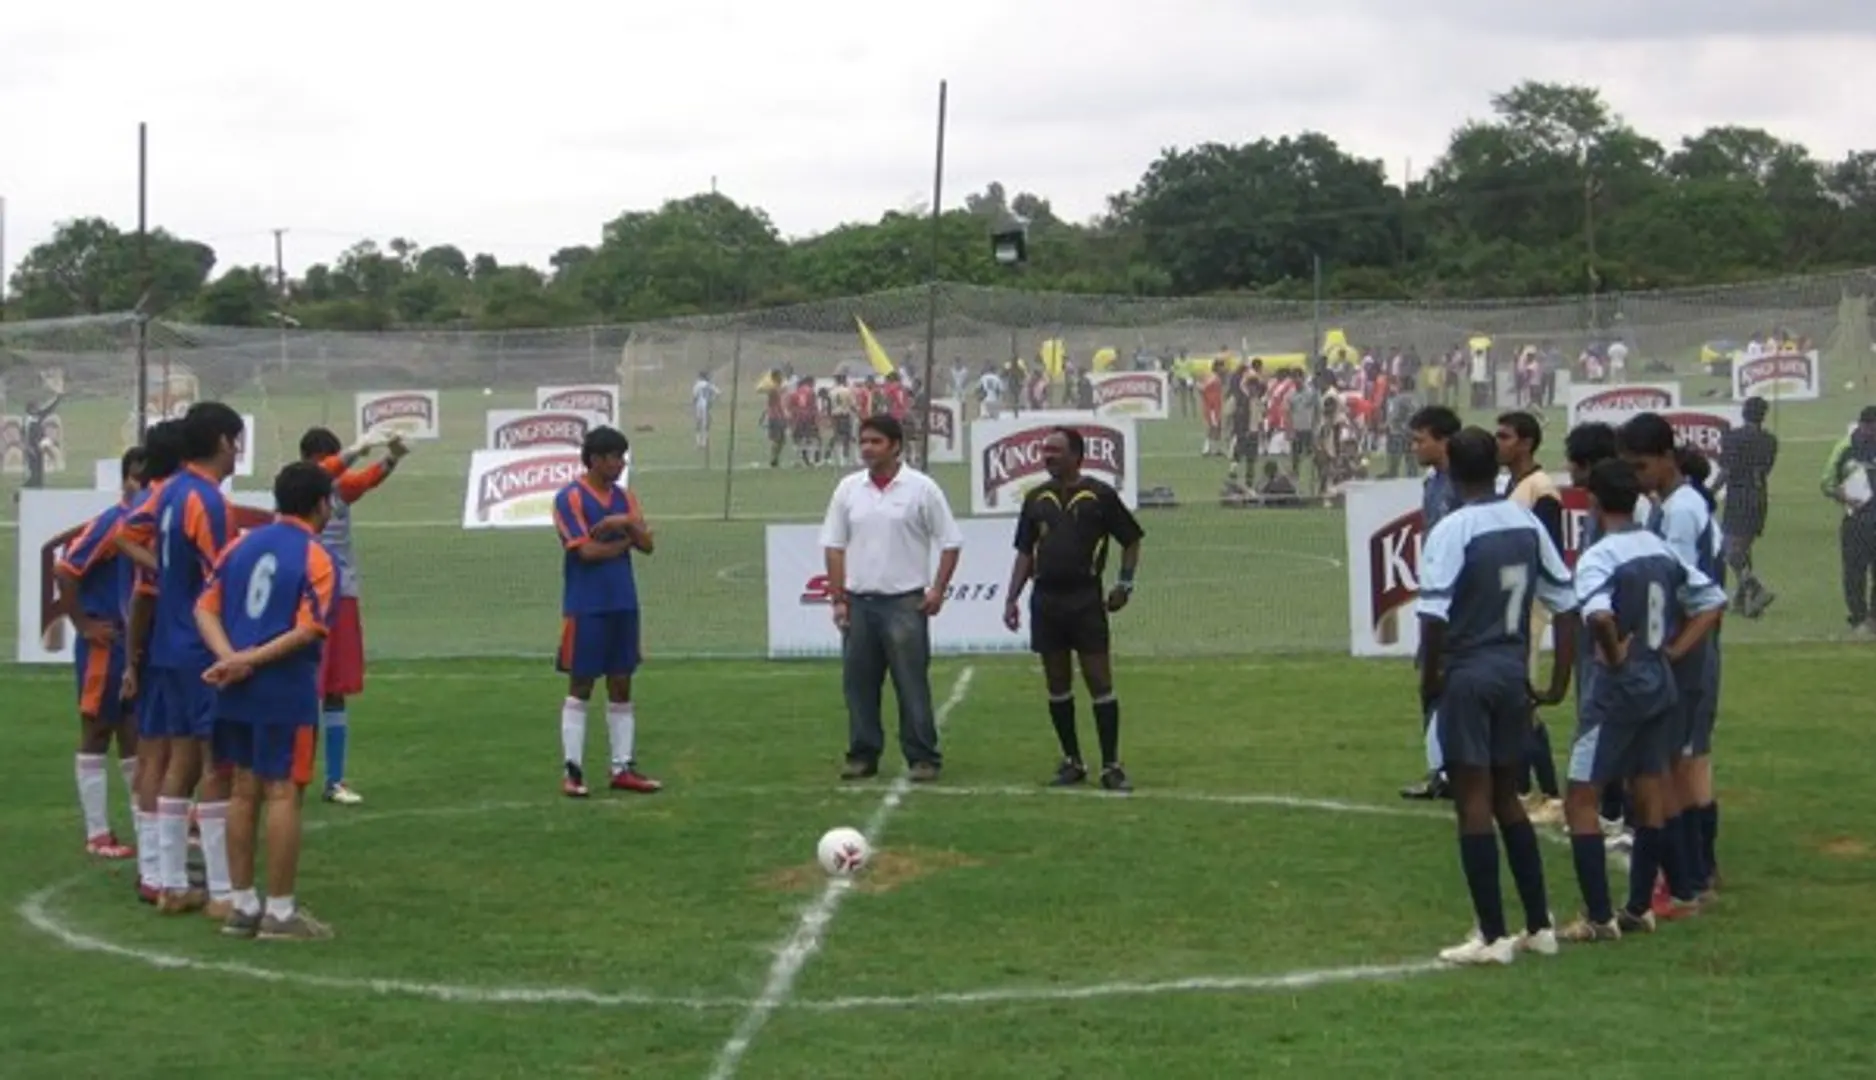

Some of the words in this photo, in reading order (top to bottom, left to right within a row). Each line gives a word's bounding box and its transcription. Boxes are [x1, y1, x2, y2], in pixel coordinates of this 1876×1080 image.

[499, 419, 584, 449] KINGFISHER
[989, 436, 1118, 480] KINGER
[484, 461, 588, 500] KINGFISH
[247, 552, 277, 619] 6
[1500, 563, 1528, 635] 7
[1647, 582, 1665, 650] 8
